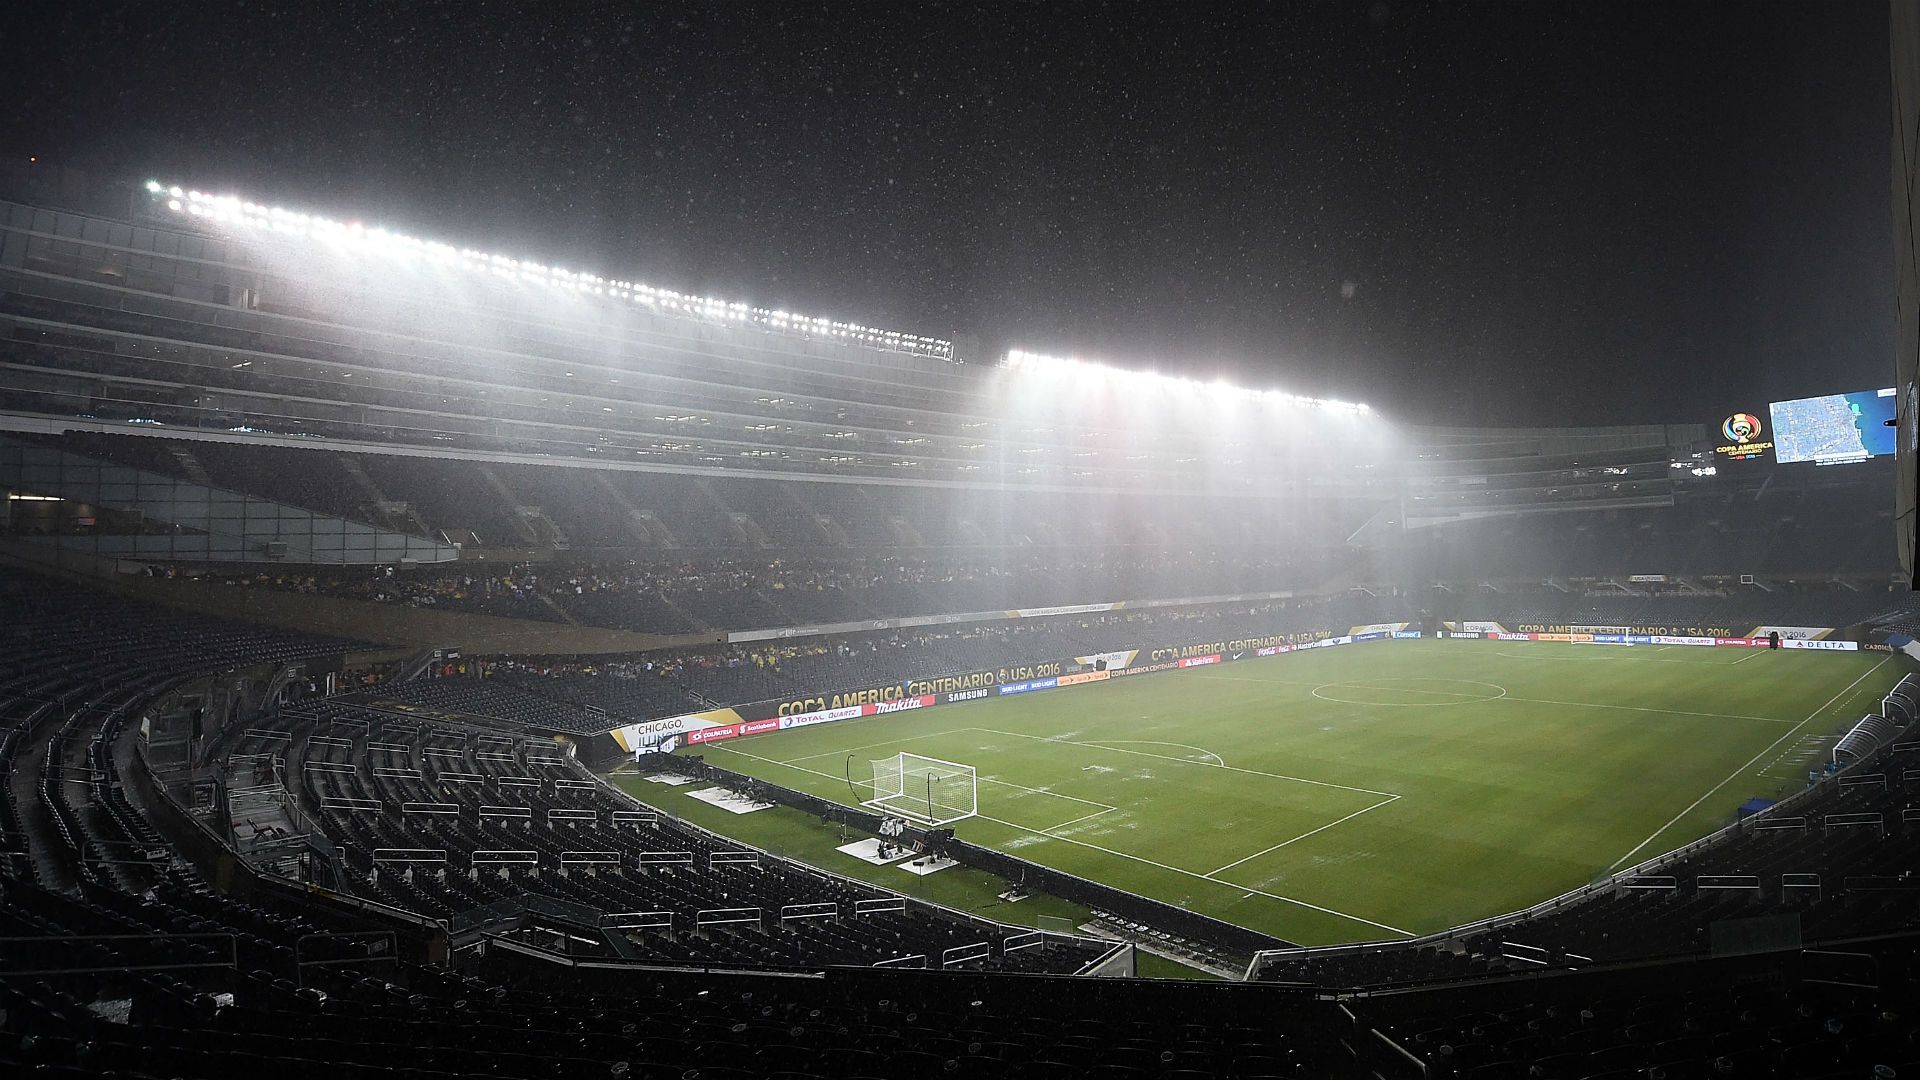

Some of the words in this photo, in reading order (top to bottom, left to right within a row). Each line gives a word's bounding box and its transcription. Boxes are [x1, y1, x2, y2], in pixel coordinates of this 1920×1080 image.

[1738, 441, 1773, 452] AMERICA
[1518, 624, 1545, 633] COPA
[1548, 625, 1593, 634] AMERICA
[1599, 626, 1667, 636] CENTENARIO
[1707, 628, 1731, 637] 2016
[1181, 642, 1225, 657] AMERICA
[1228, 635, 1285, 652] CENTENARIO
[1297, 632, 1313, 643] USA
[1807, 641, 1845, 649] DELTA
[831, 685, 904, 710] AMERICA
[909, 671, 994, 696] CENTENARIO
[1011, 666, 1035, 681] USA
[1037, 662, 1060, 678] 2016
[948, 688, 988, 702] SAMSUNG
[638, 719, 684, 735] CHICAGO,
[703, 728, 733, 739] COLPATRIA
